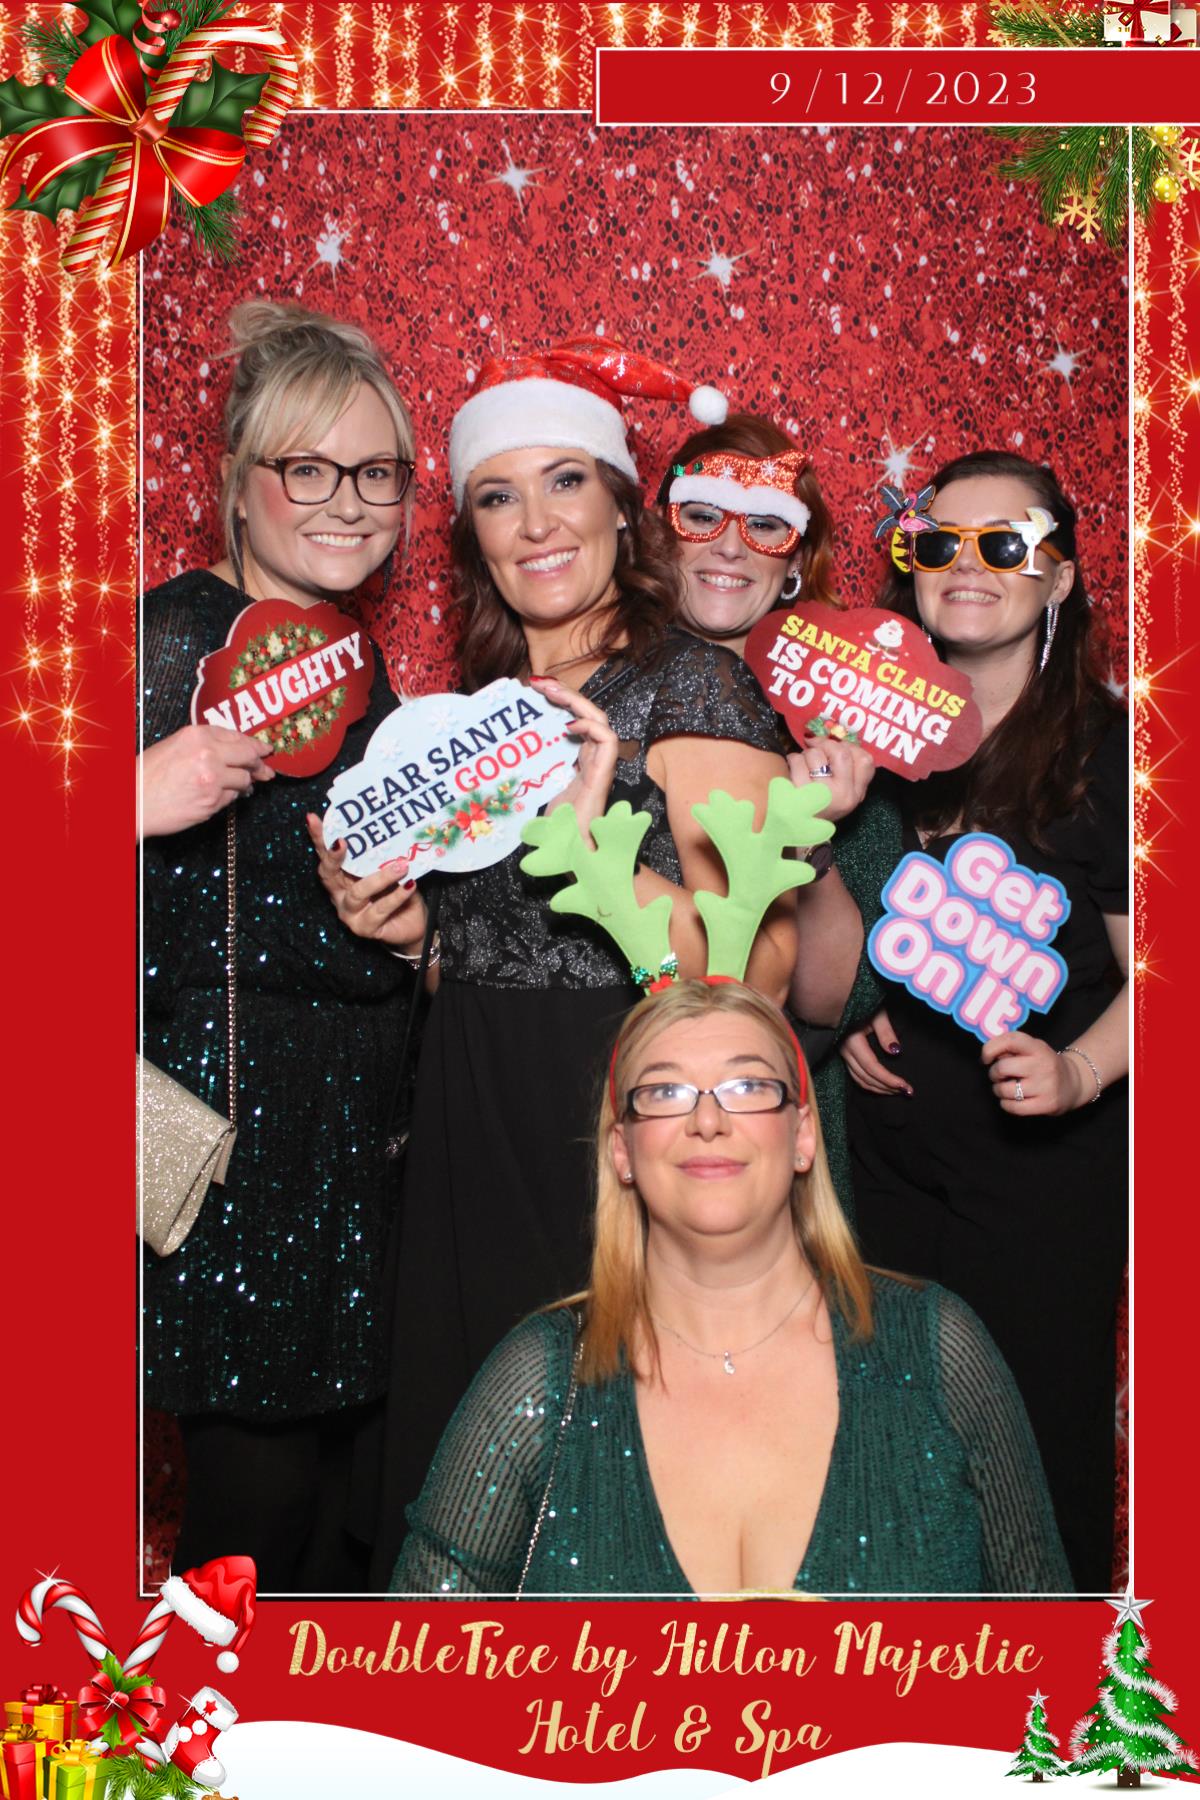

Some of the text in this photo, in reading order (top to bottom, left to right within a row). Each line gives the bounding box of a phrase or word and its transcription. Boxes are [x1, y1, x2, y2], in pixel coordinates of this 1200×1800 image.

[767, 635, 952, 745] IS COMING
[781, 614, 966, 717] SANTA CLAUS
[336, 698, 543, 828] DEAR SANTA
[768, 666, 926, 765] TO TOWN
[343, 781, 456, 860] DEFINE
[889, 860, 1060, 1006] Down
[953, 841, 1062, 938] Get
[876, 918, 964, 1006] On
[960, 972, 1022, 1038] It
